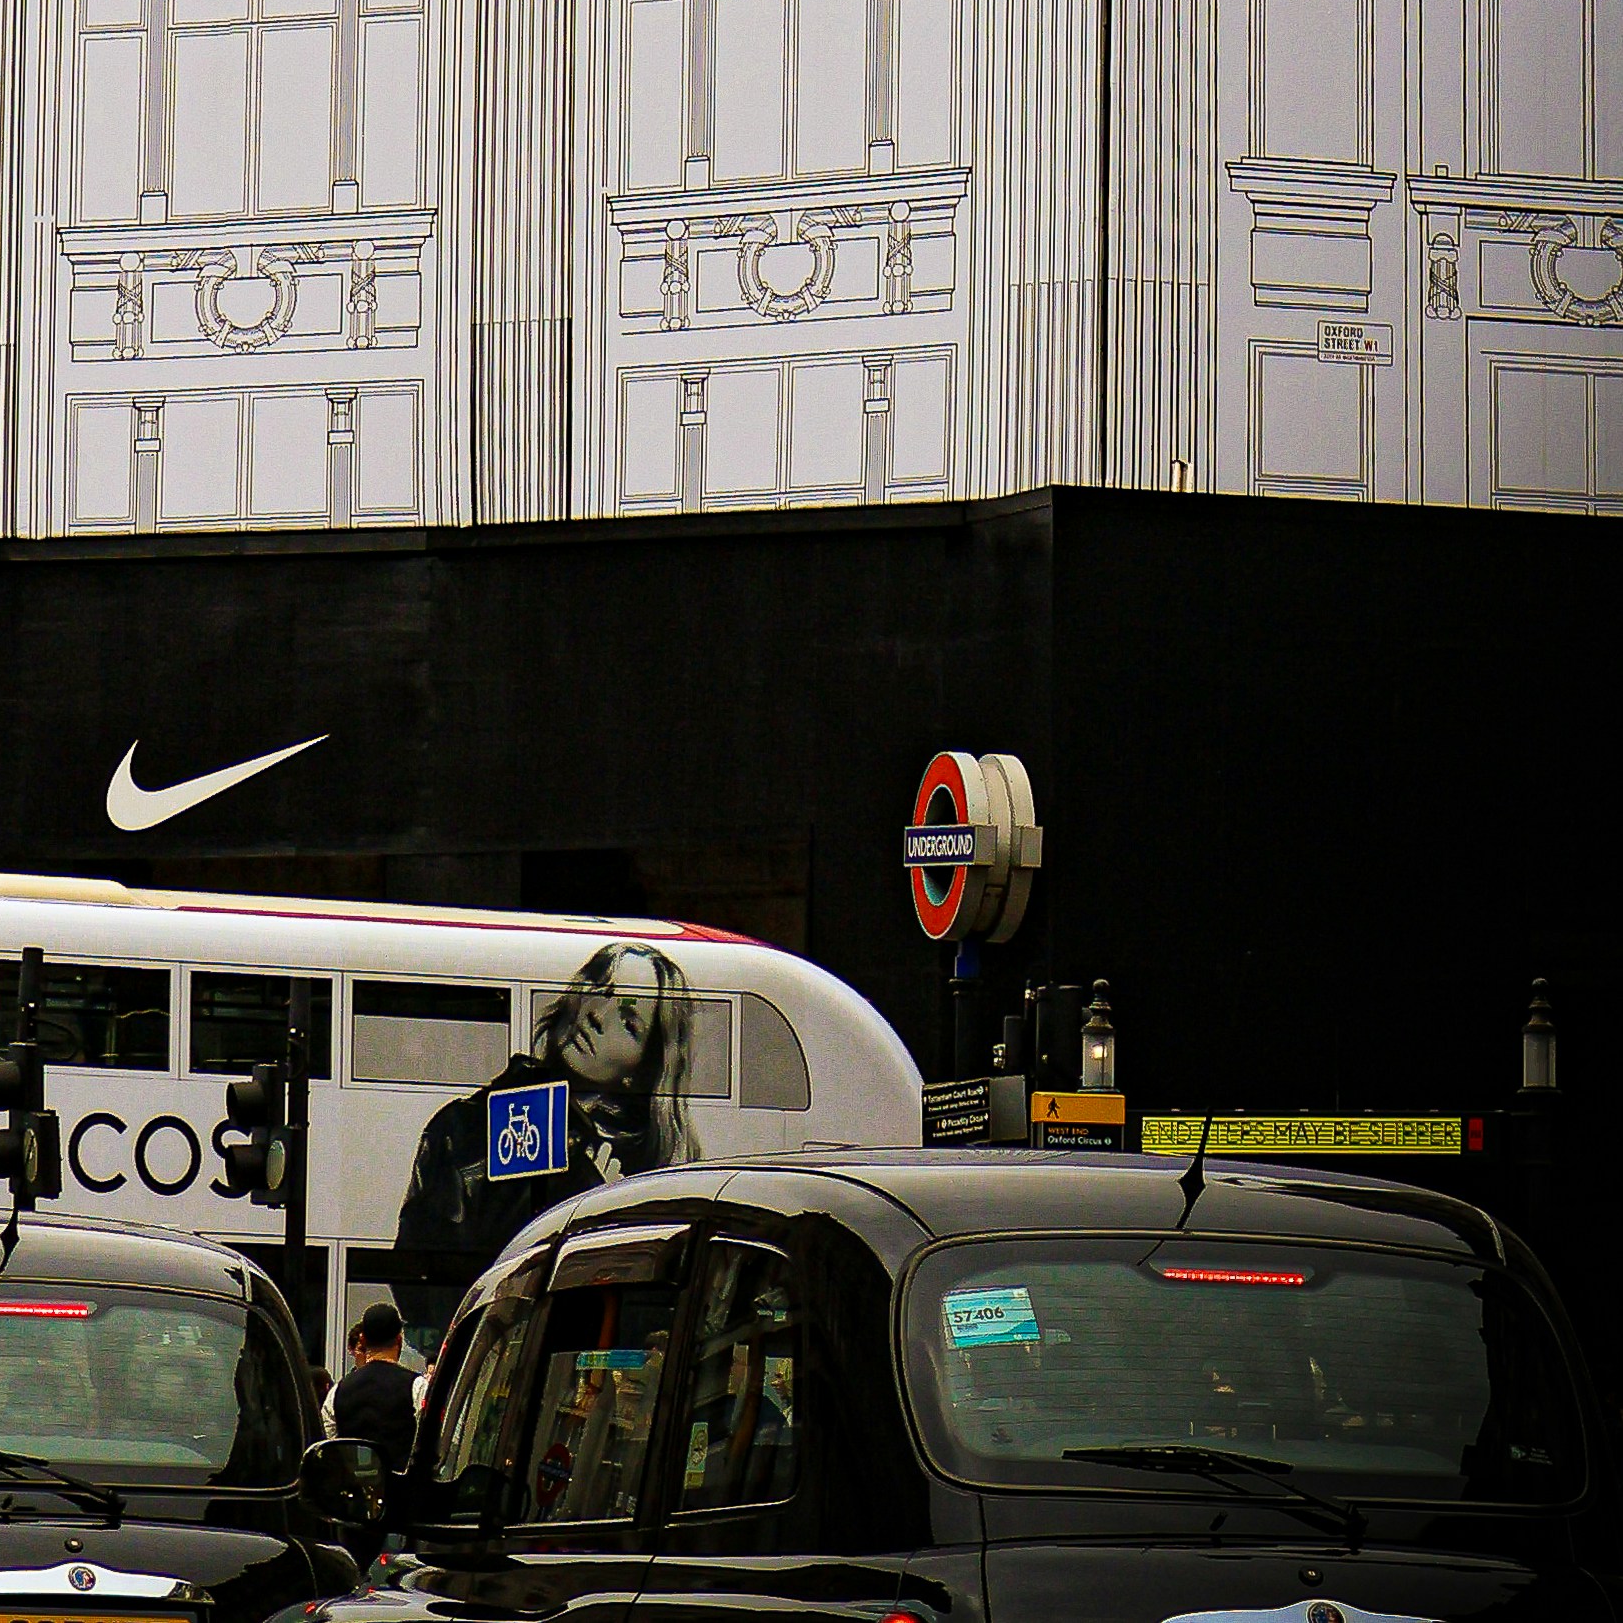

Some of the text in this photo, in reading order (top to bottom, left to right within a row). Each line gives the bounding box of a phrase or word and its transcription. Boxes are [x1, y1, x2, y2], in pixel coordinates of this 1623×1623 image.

[1324, 326, 1363, 338] OXFORD
[1324, 338, 1378, 352] STREET W1
[908, 834, 973, 857] UNDERGROUND
[1048, 1135, 1102, 1145] Oxford Circus
[1275, 1121, 1321, 1145] MAY
[954, 1306, 1005, 1323] 57406
